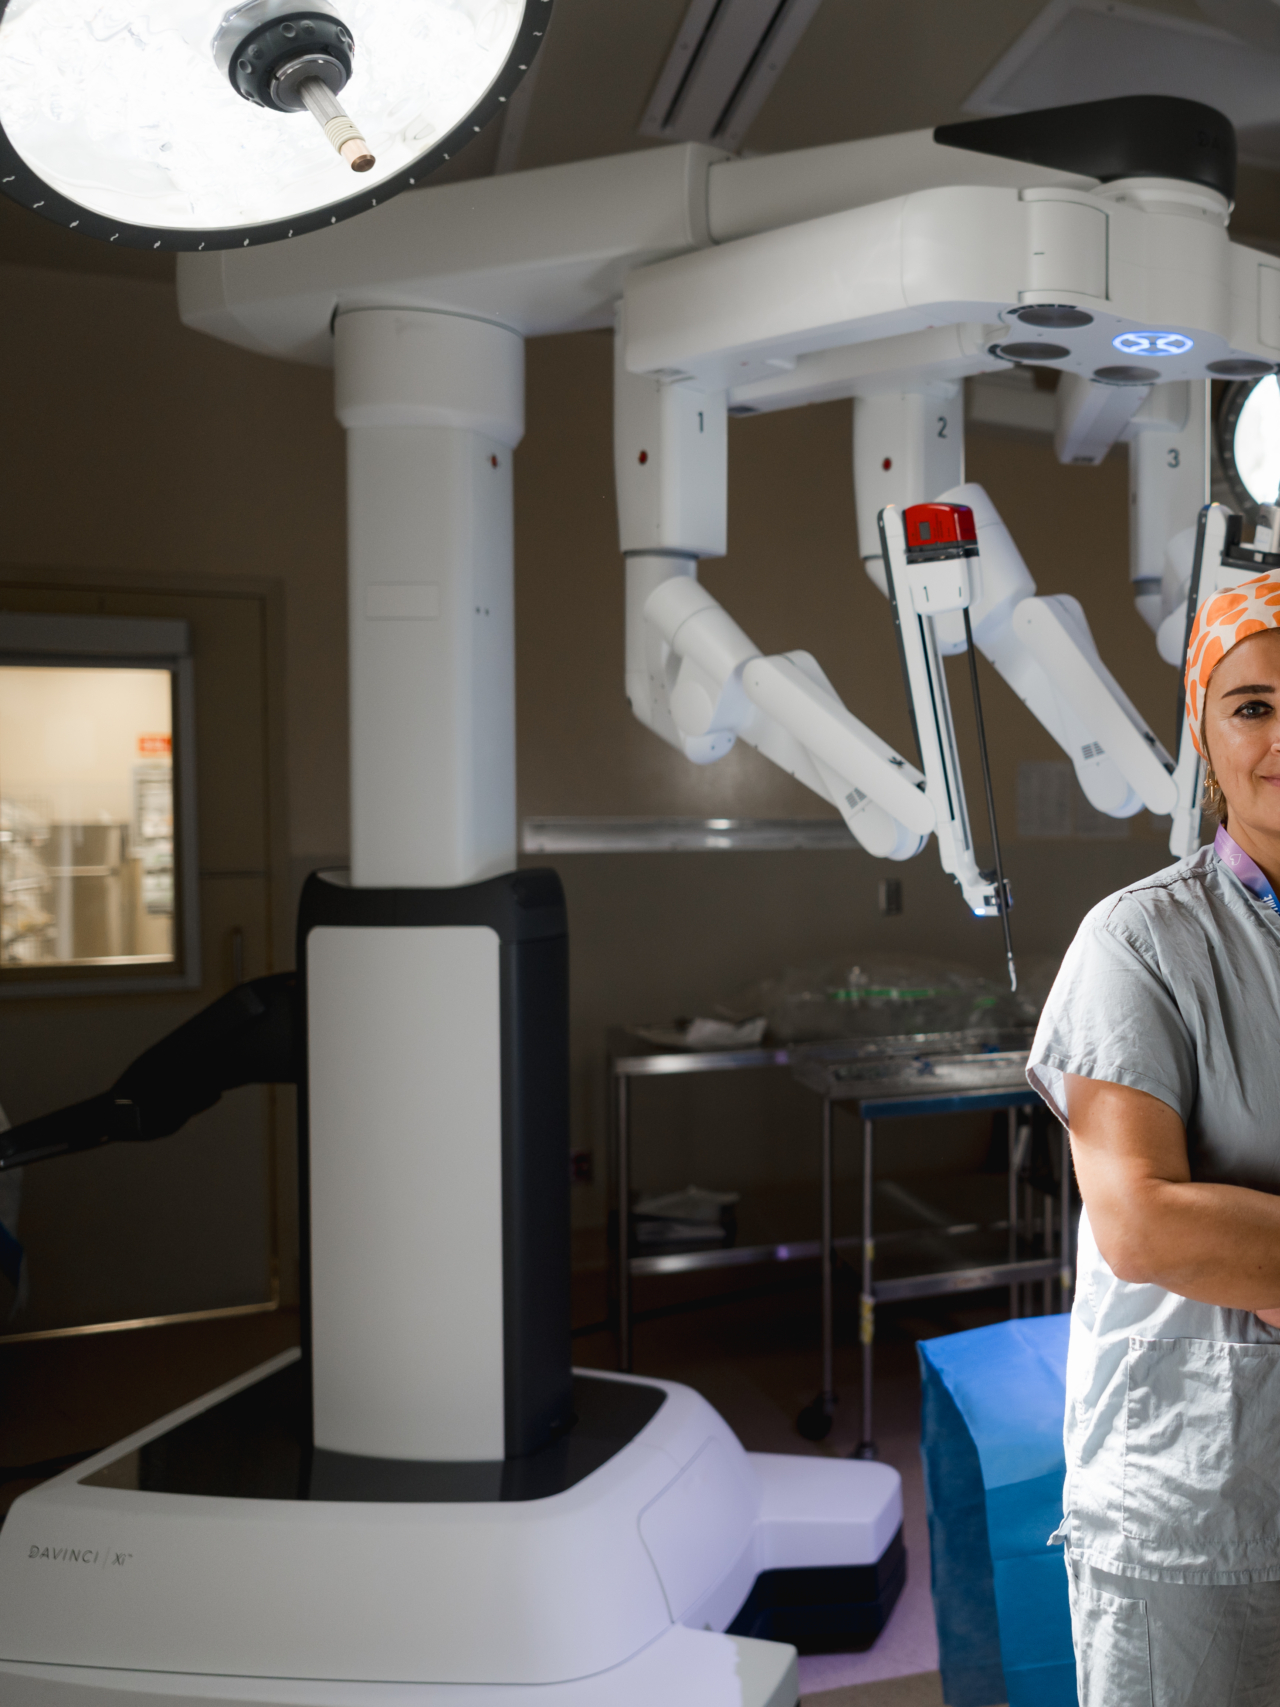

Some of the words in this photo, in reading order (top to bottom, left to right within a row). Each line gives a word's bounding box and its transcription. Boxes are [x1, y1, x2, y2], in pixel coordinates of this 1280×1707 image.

[697, 411, 704, 434] 1
[936, 416, 948, 439] 2
[1167, 447, 1180, 468] 3
[923, 585, 929, 603] 1
[27, 1544, 100, 1564] DAVINCI
